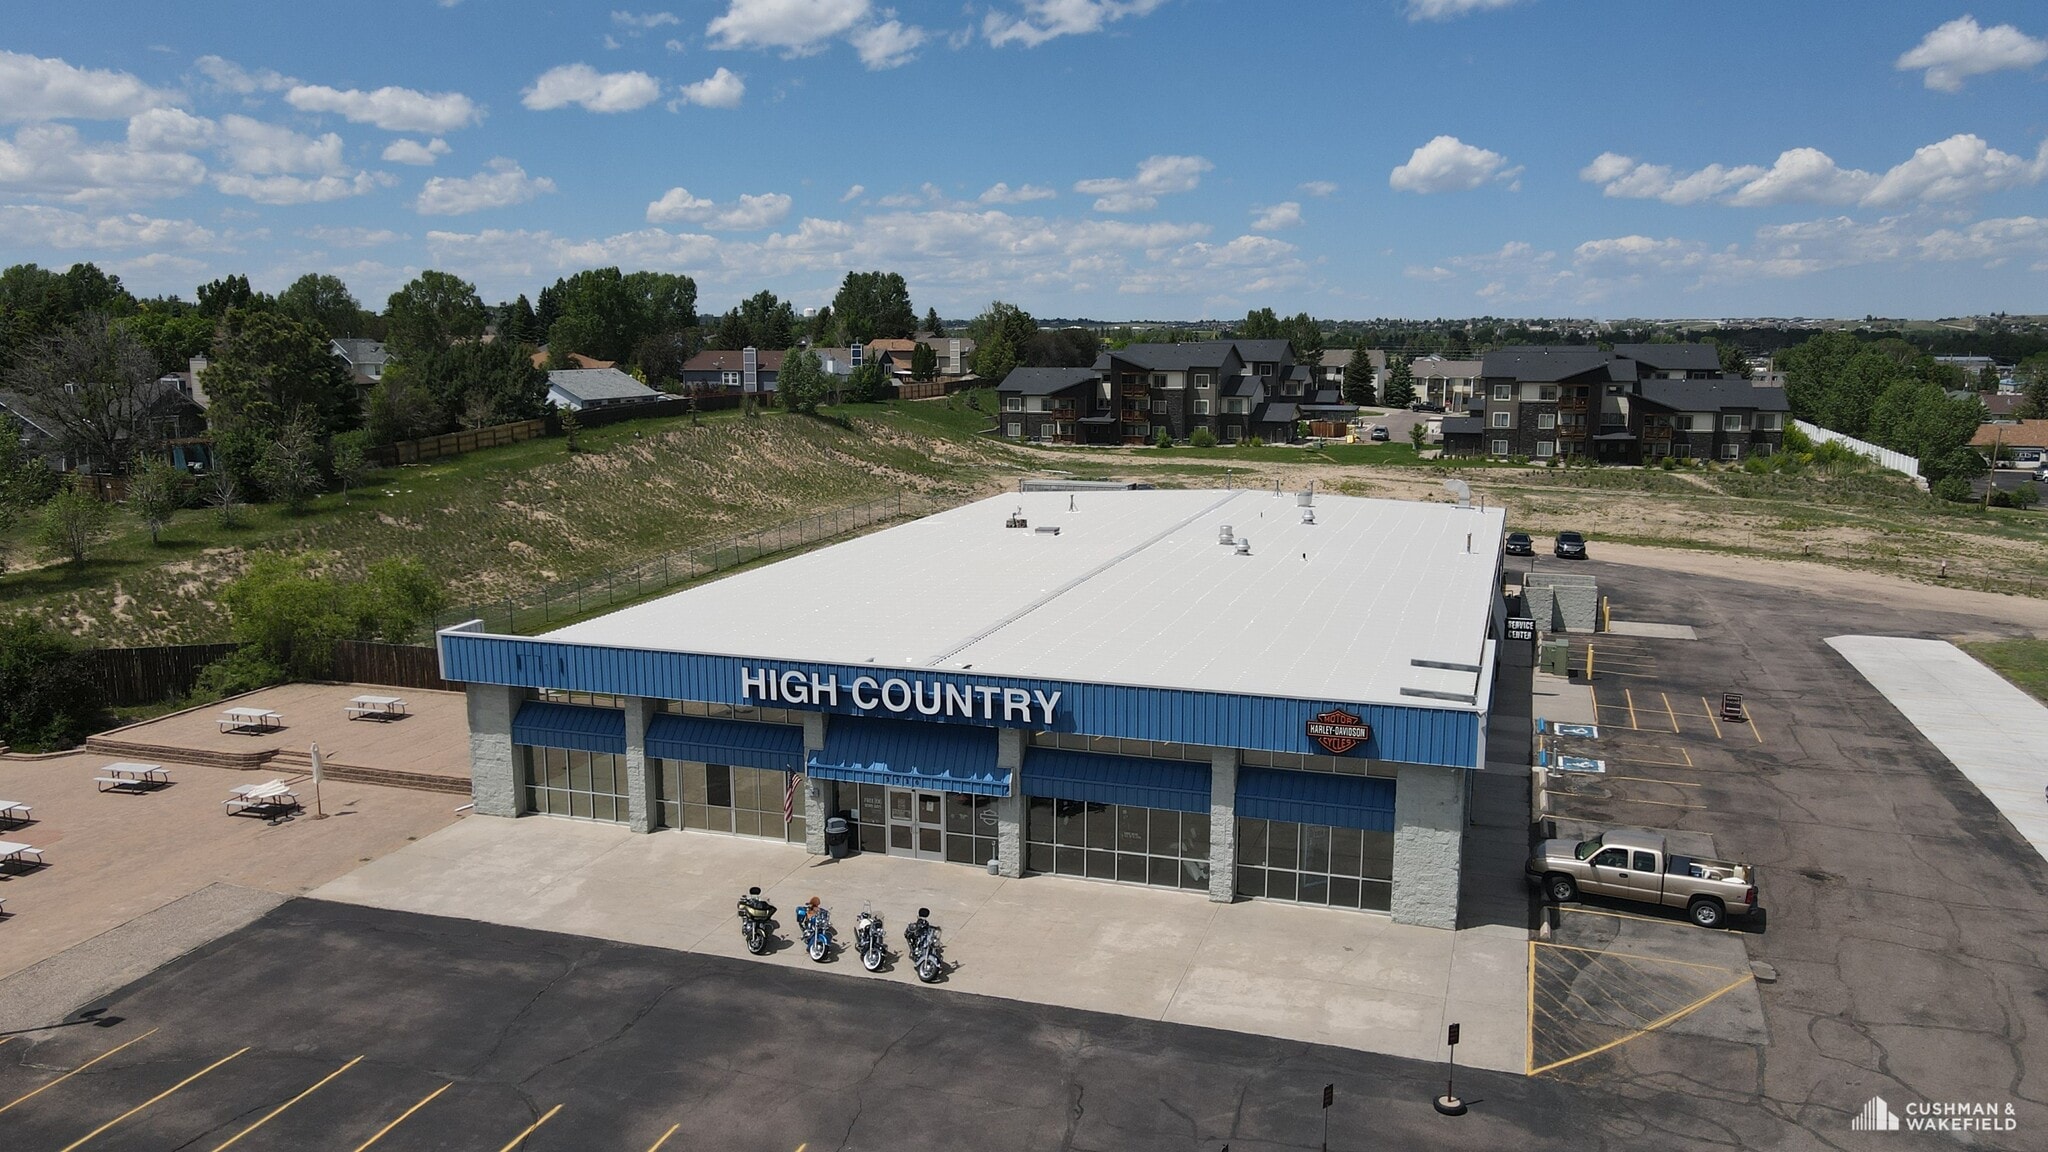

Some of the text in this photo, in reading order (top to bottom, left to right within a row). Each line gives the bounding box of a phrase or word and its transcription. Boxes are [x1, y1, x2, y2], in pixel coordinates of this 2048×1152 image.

[1507, 620, 1534, 630] SERVICE
[1507, 630, 1532, 640] CENTER
[741, 666, 1062, 725] HIGH COUNTRY
[1323, 713, 1353, 725] MOTOR
[1310, 724, 1366, 738] HARLEY-DAVIDSON
[1322, 737, 1352, 750] CYCLES
